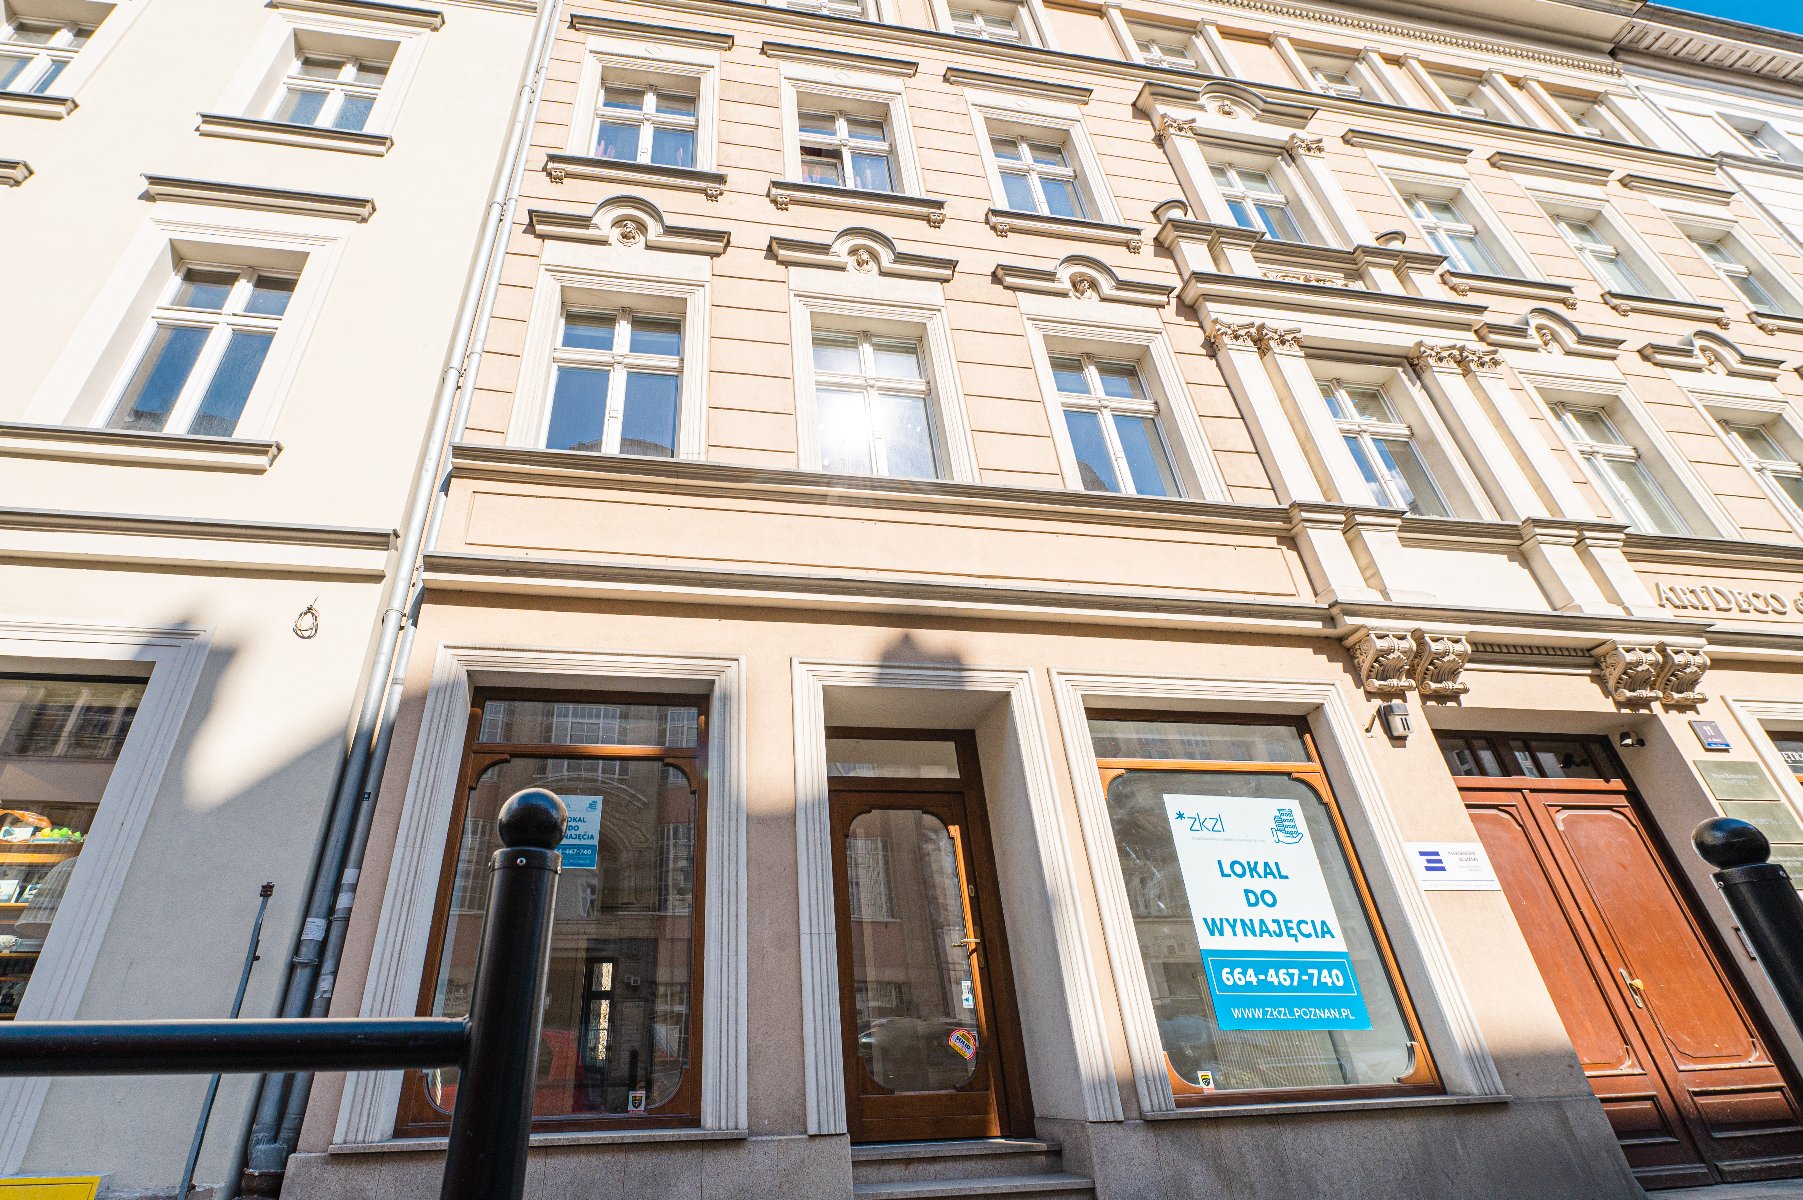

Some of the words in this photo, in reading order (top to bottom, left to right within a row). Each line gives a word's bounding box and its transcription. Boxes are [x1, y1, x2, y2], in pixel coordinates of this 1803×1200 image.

[1217, 859, 1289, 880] LOKAL
[1243, 888, 1278, 908] DO
[1202, 917, 1335, 942] WYNAJĘCIA
[1221, 967, 1345, 987] 664-467-740
[1230, 1007, 1355, 1020] WWW.ZKZL.POZNAN.PL
